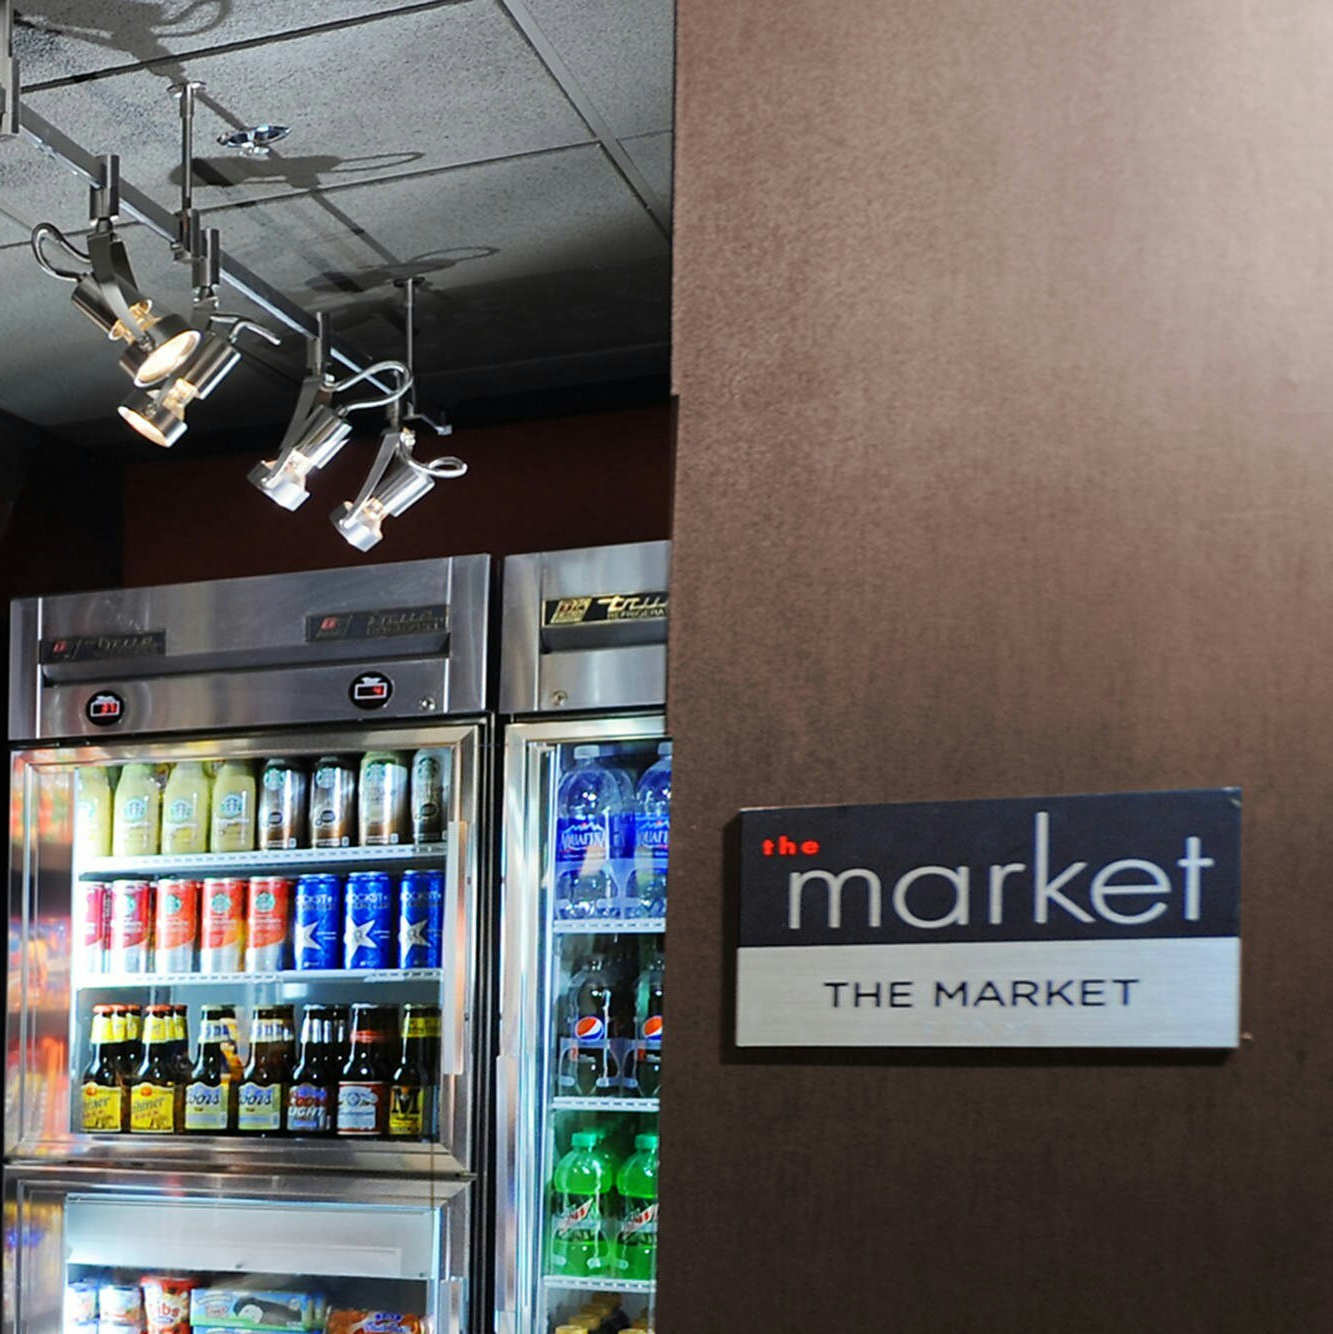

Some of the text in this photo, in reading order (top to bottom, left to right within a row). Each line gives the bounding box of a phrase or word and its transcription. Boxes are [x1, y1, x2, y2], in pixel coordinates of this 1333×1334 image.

[761, 835, 820, 856] the
[788, 811, 1215, 930] market
[824, 978, 1140, 1008] THE MARKET
